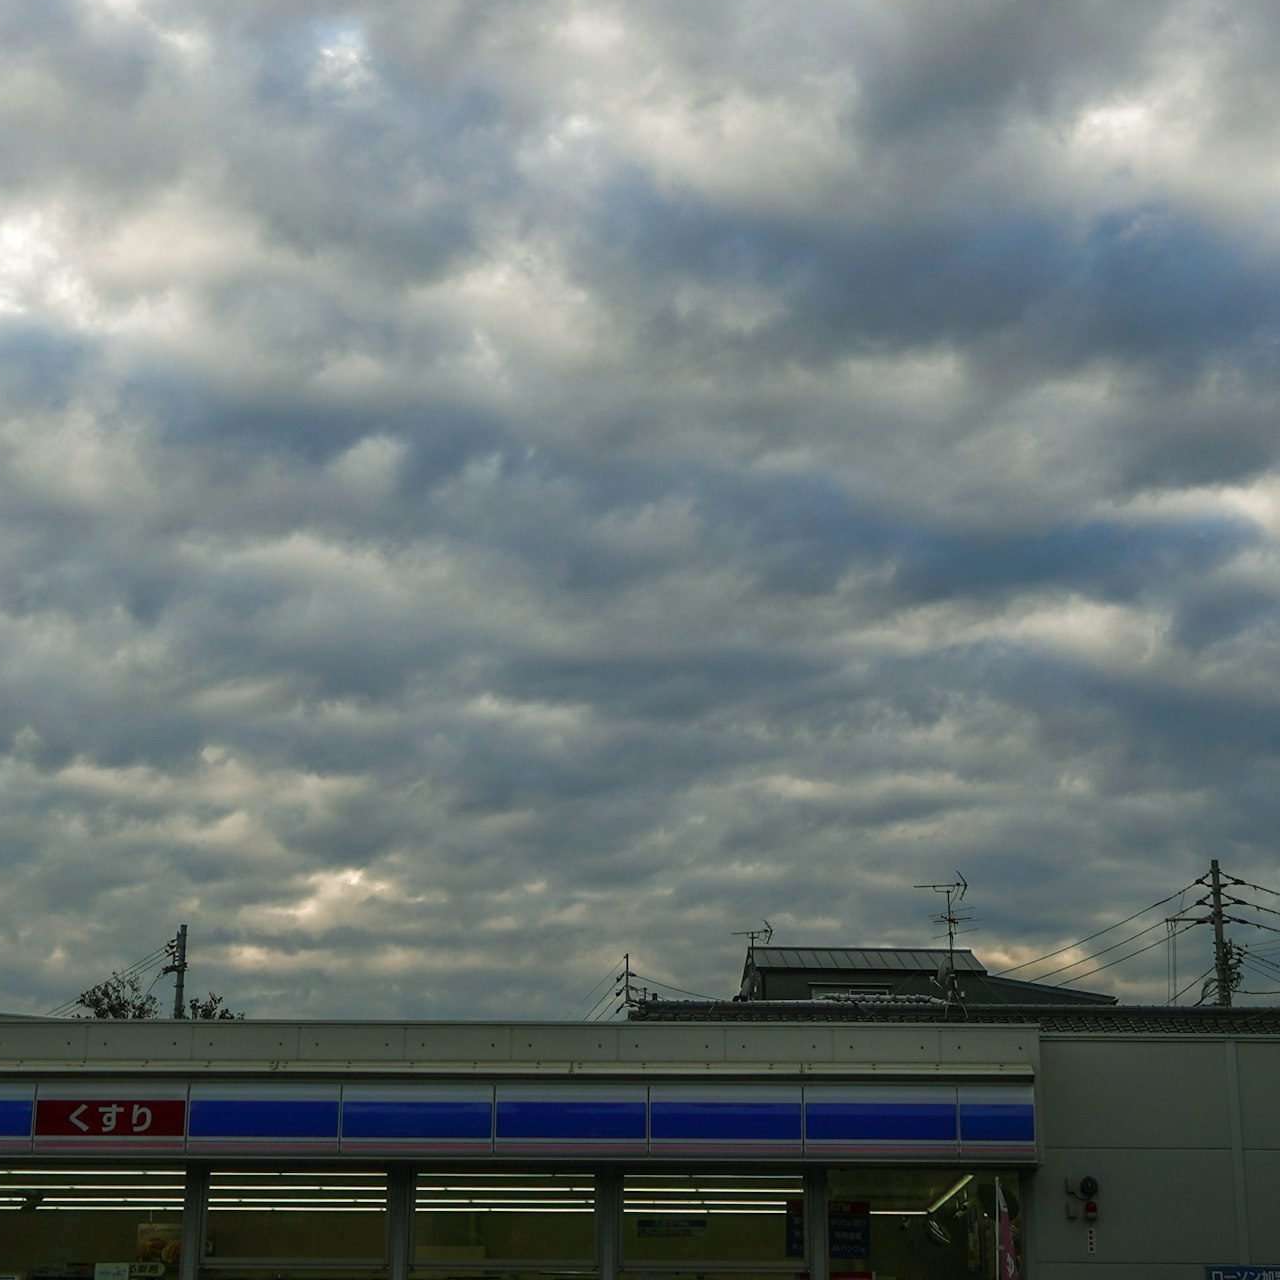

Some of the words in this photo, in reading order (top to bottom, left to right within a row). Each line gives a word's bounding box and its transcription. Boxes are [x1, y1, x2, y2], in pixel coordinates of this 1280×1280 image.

[69, 1104, 152, 1132] くすり
[829, 1203, 852, 1212] ATM
